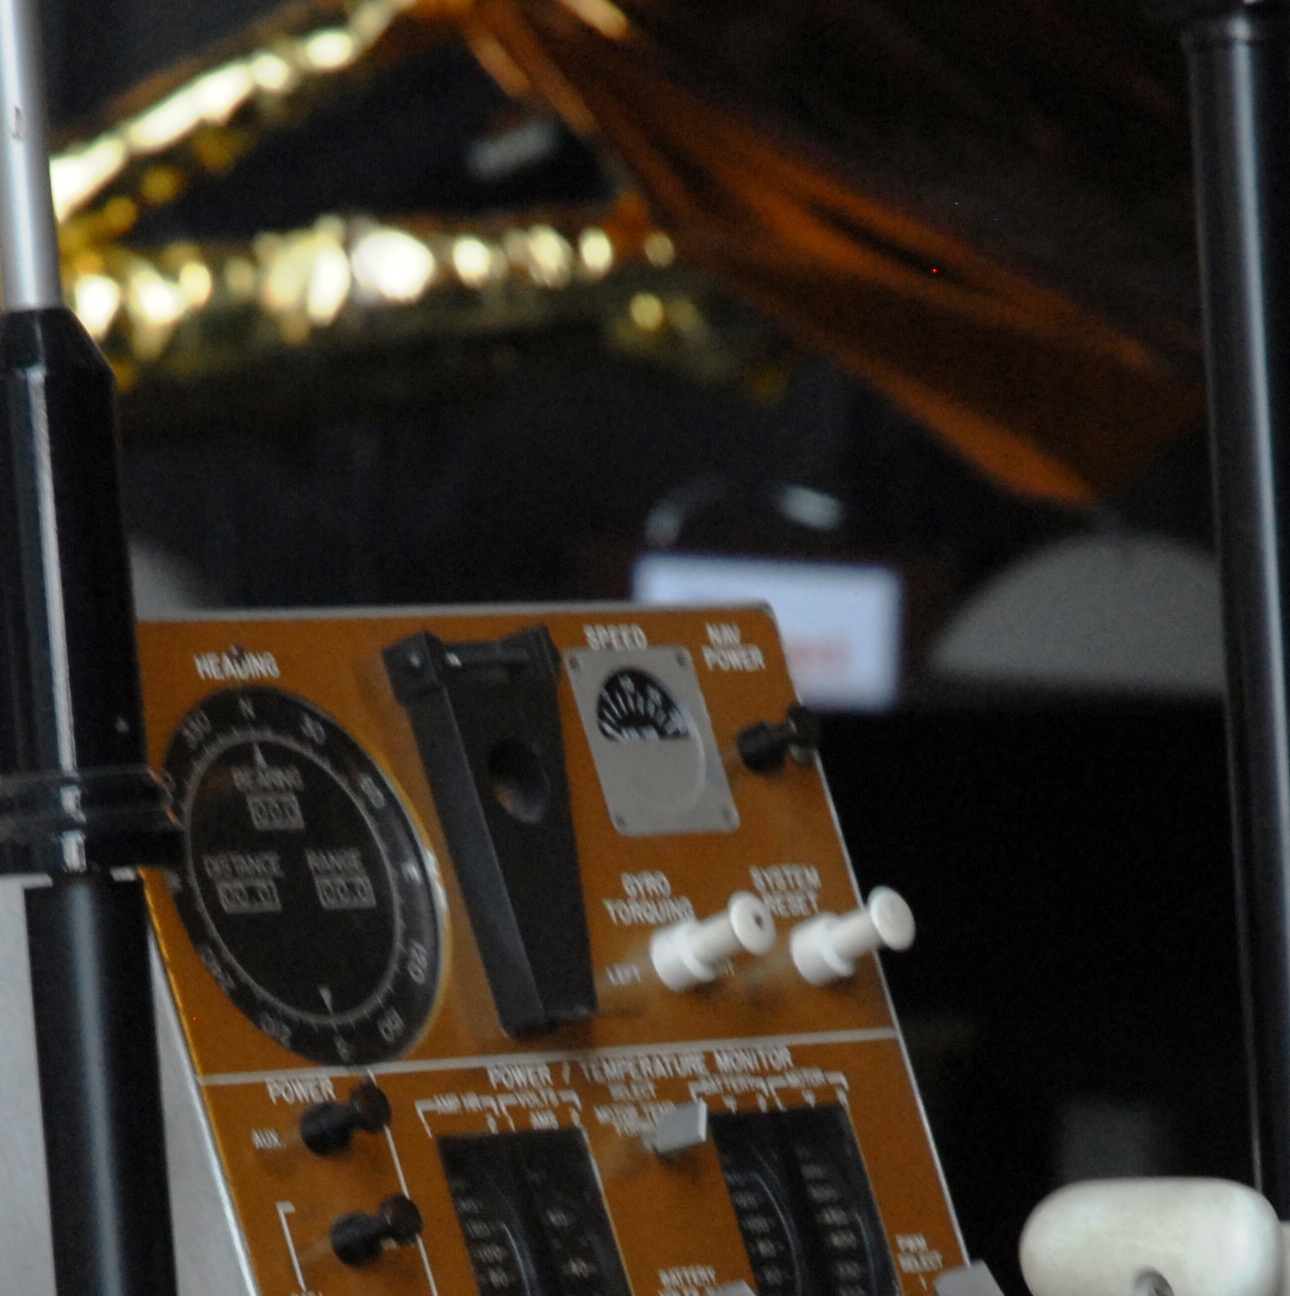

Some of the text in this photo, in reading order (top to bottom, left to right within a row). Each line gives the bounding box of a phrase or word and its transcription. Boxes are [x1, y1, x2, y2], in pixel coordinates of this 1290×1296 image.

[583, 623, 648, 650] SPEED
[705, 622, 741, 645] NAV
[193, 651, 280, 680] HEADING
[702, 644, 765, 671] POWER
[621, 870, 671, 899] GYRO
[749, 863, 822, 892] SYSTEM
[602, 895, 695, 926] TORQUING
[487, 1061, 554, 1090] POWER
[579, 1051, 708, 1083] TEMPERATURE
[712, 1044, 793, 1073] MONITOR
[265, 1077, 336, 1105] POWER
[658, 1265, 716, 1287] BATTERY
